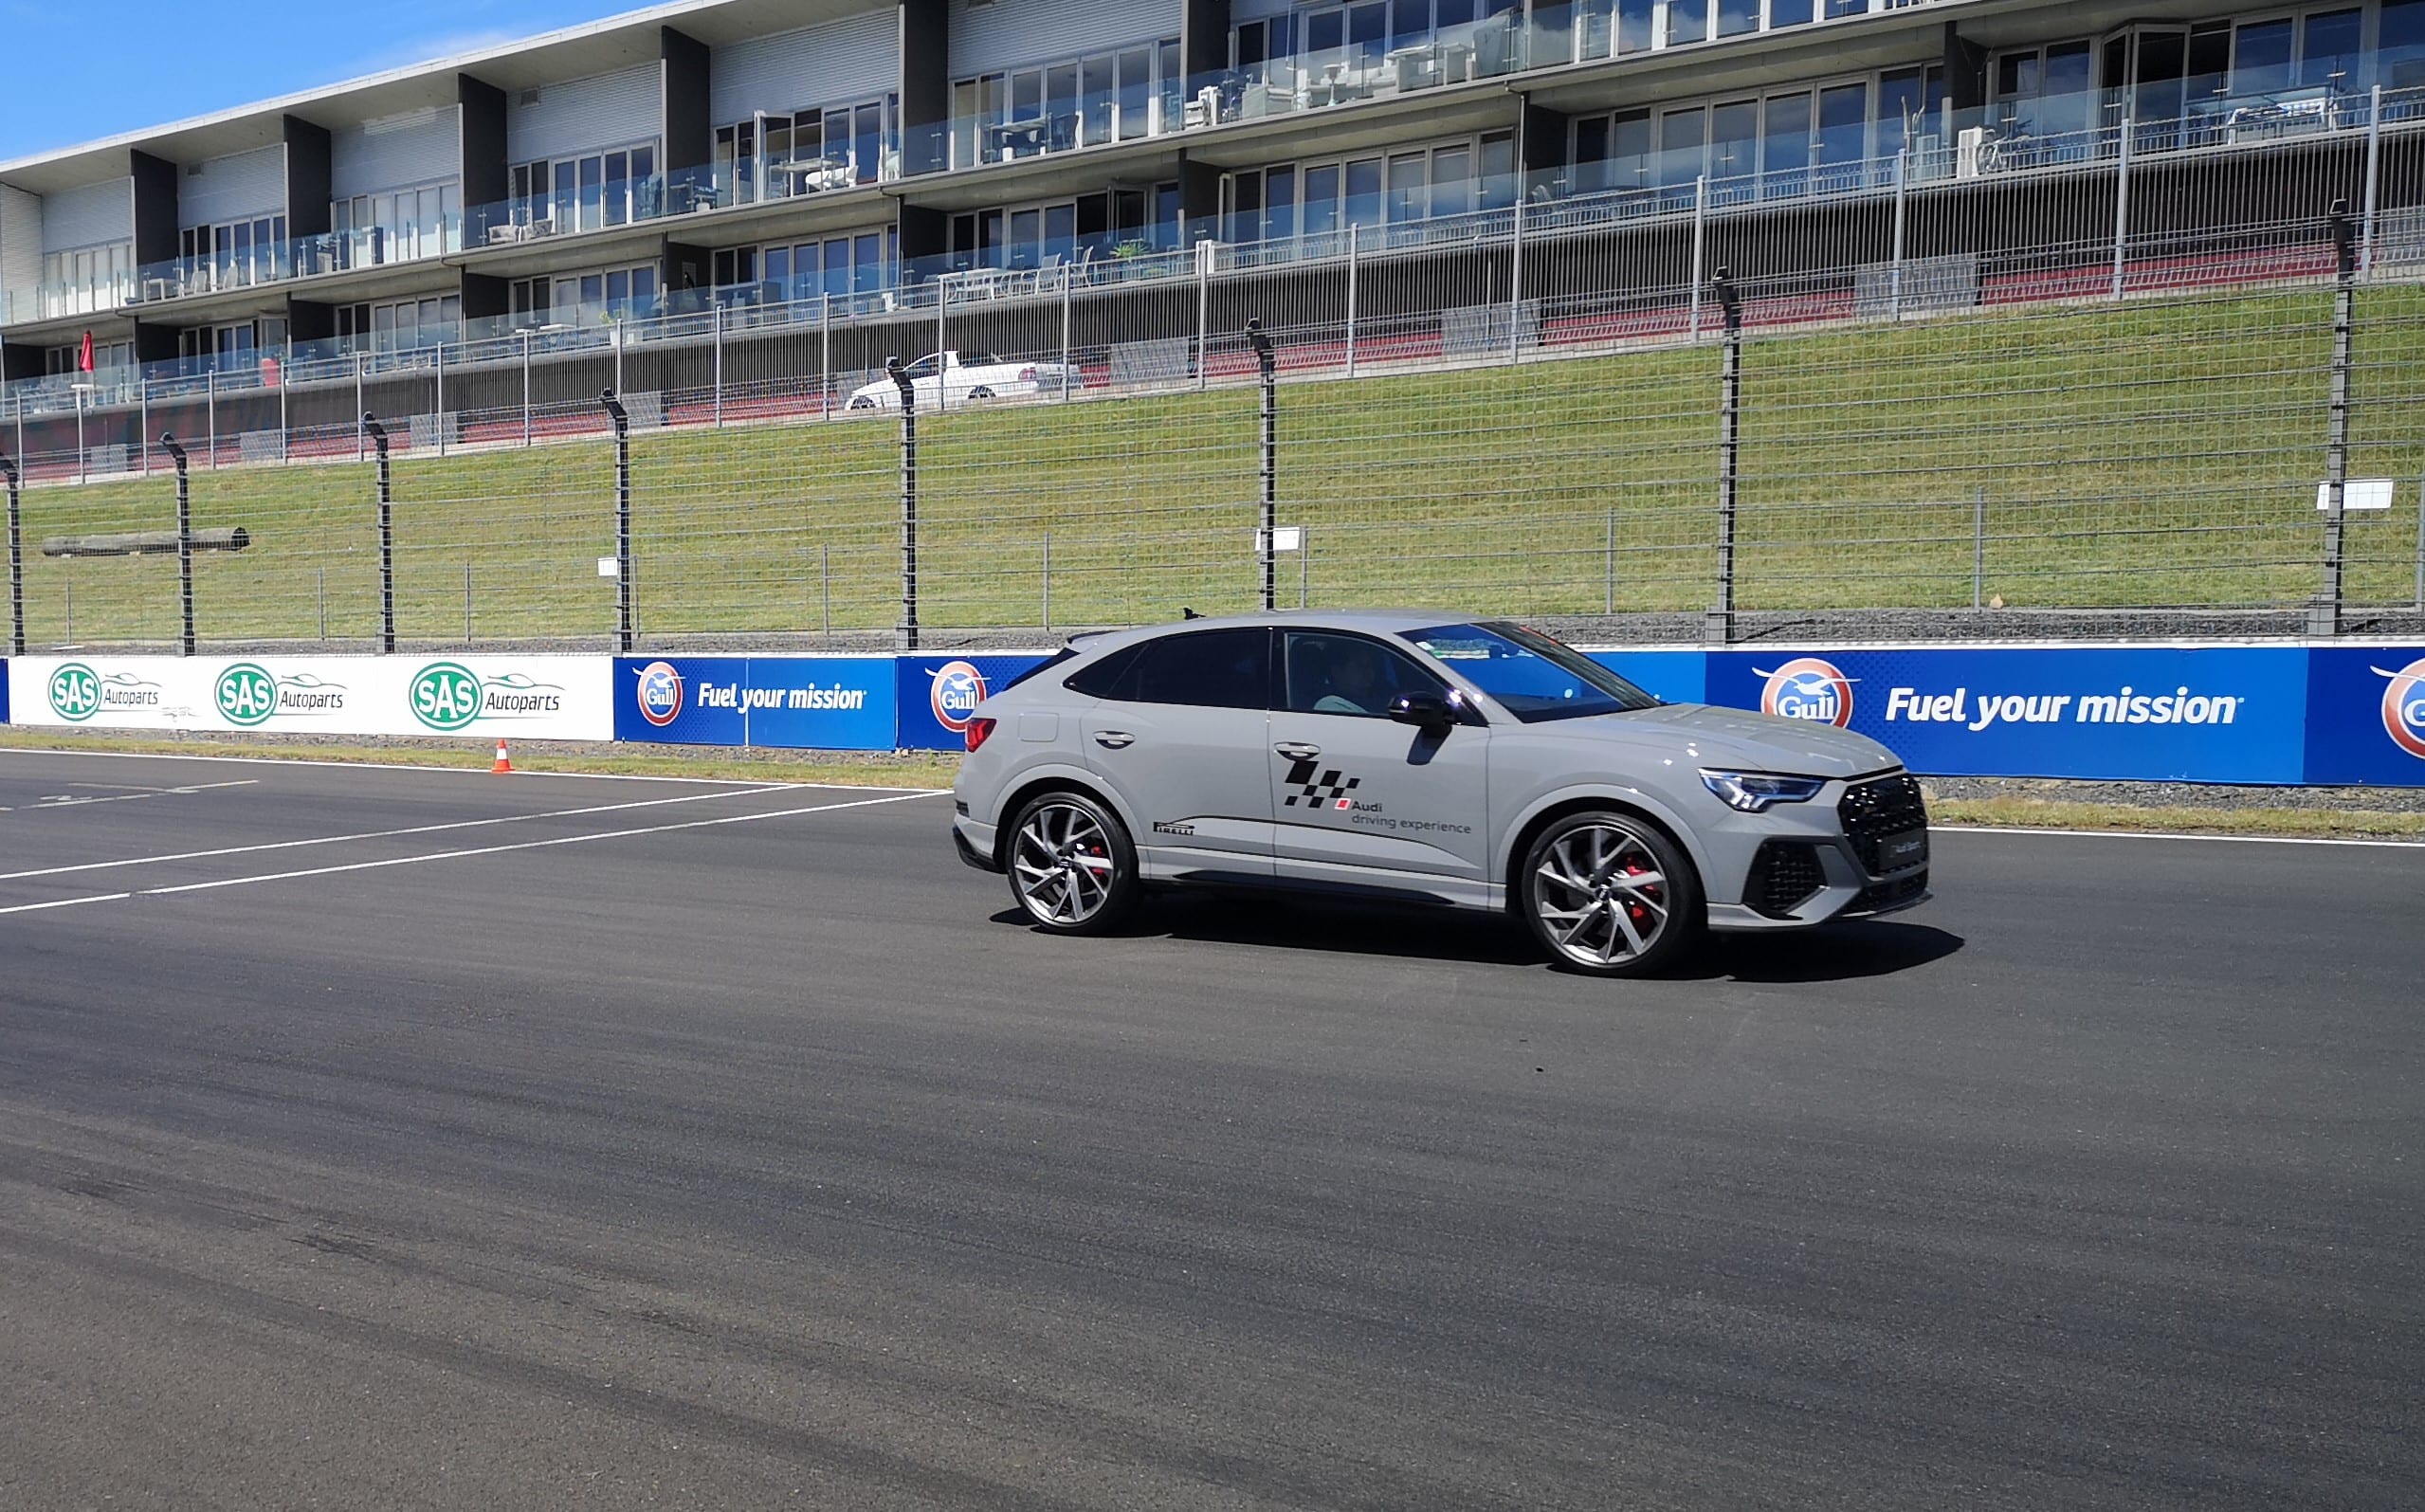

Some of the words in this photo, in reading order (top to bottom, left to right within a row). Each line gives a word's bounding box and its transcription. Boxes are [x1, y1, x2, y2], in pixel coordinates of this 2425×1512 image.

[54, 672, 96, 711] SAS
[103, 688, 158, 707] Autoparts
[222, 674, 270, 715] SAS
[280, 691, 343, 711] Autoparts
[417, 674, 474, 719] SAS
[485, 692, 559, 713] Autoparts
[647, 687, 674, 705] Gull
[698, 683, 738, 707] Fuel
[738, 688, 786, 714] your
[788, 682, 864, 709] mission
[941, 689, 975, 710] Gull
[1778, 696, 1835, 720] Gull
[1886, 687, 1966, 721] Fuel
[1967, 695, 2071, 732] your
[2075, 685, 2236, 724] mission
[1352, 801, 1383, 812] Audi
[1153, 821, 1194, 836] PIRELLI
[1351, 813, 1396, 829] driving
[1400, 818, 1471, 834] experience
